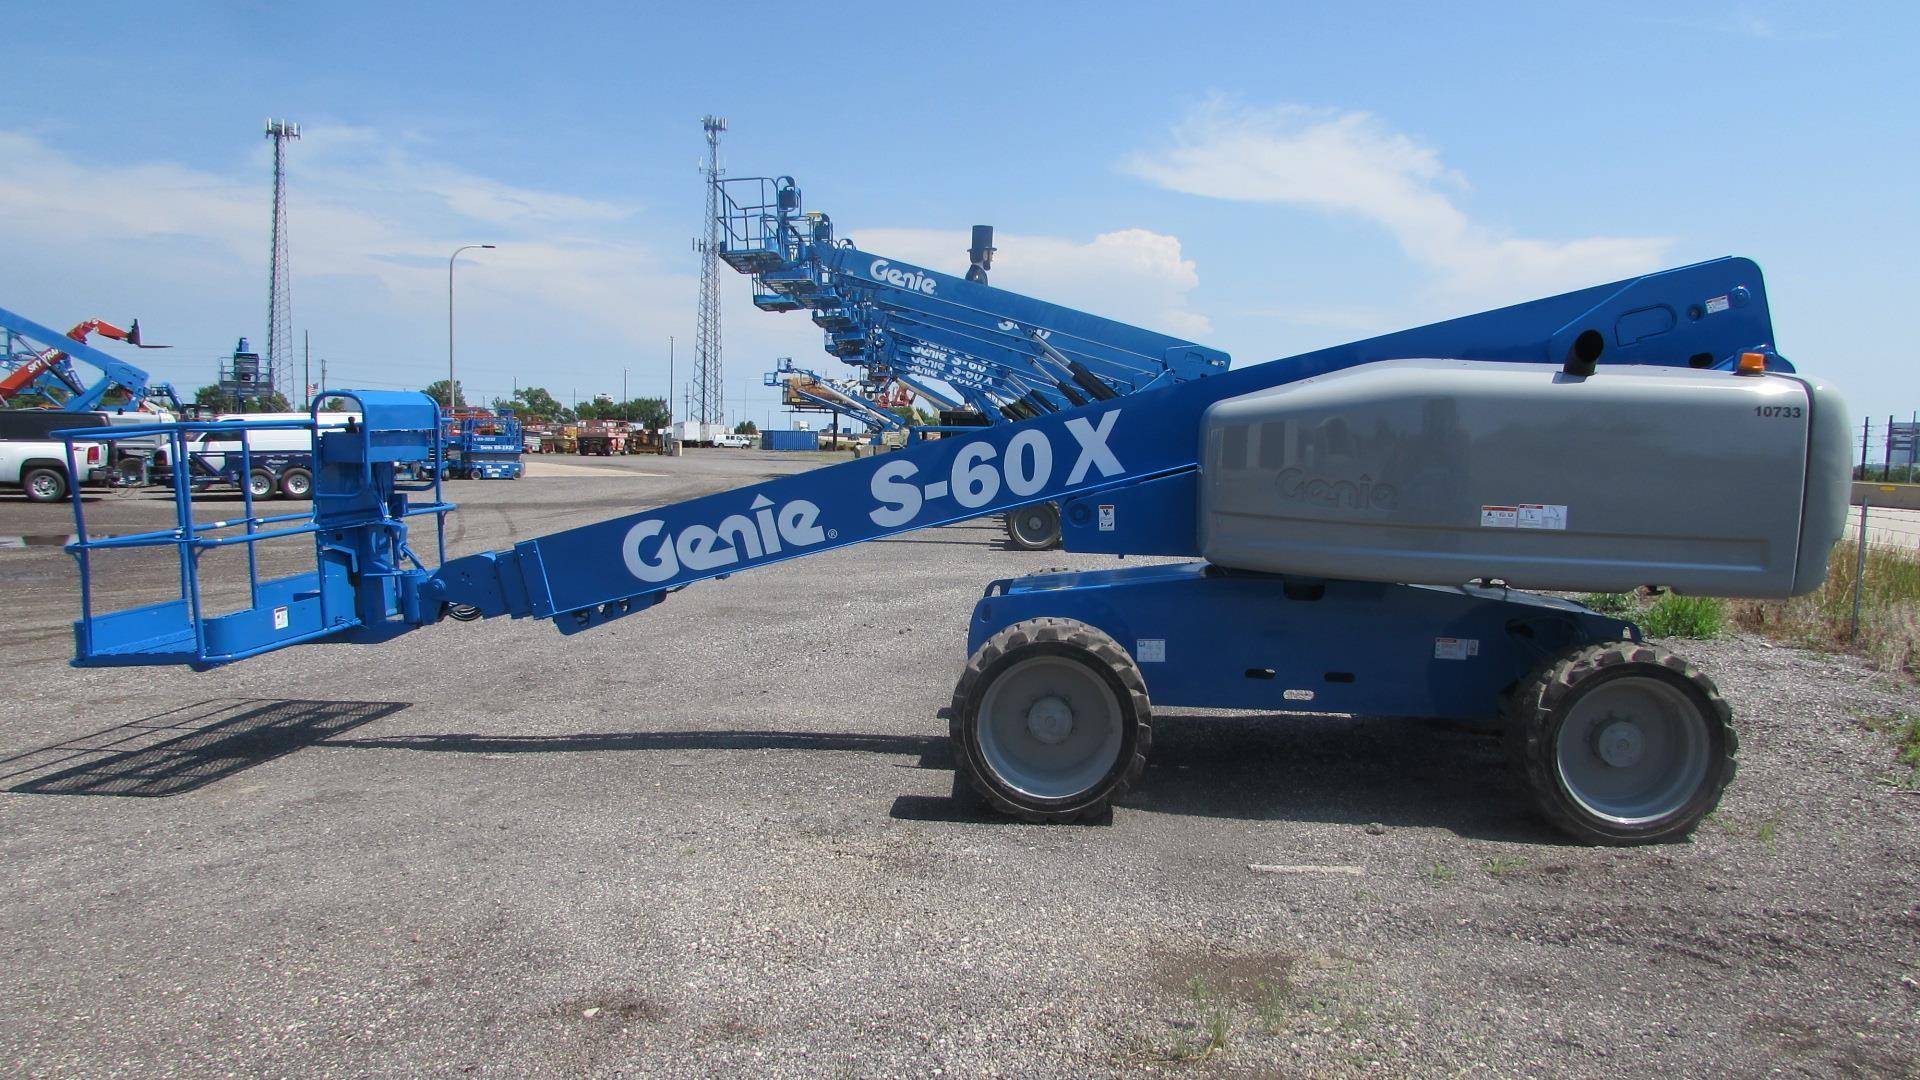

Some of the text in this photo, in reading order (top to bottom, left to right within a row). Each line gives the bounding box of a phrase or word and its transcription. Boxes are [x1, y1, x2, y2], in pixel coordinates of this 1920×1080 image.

[870, 260, 937, 294] Genie
[1754, 406, 1801, 418] 10733
[869, 408, 1126, 528] S-60 X
[1275, 467, 1399, 512] Genie
[622, 493, 826, 583] Genie
